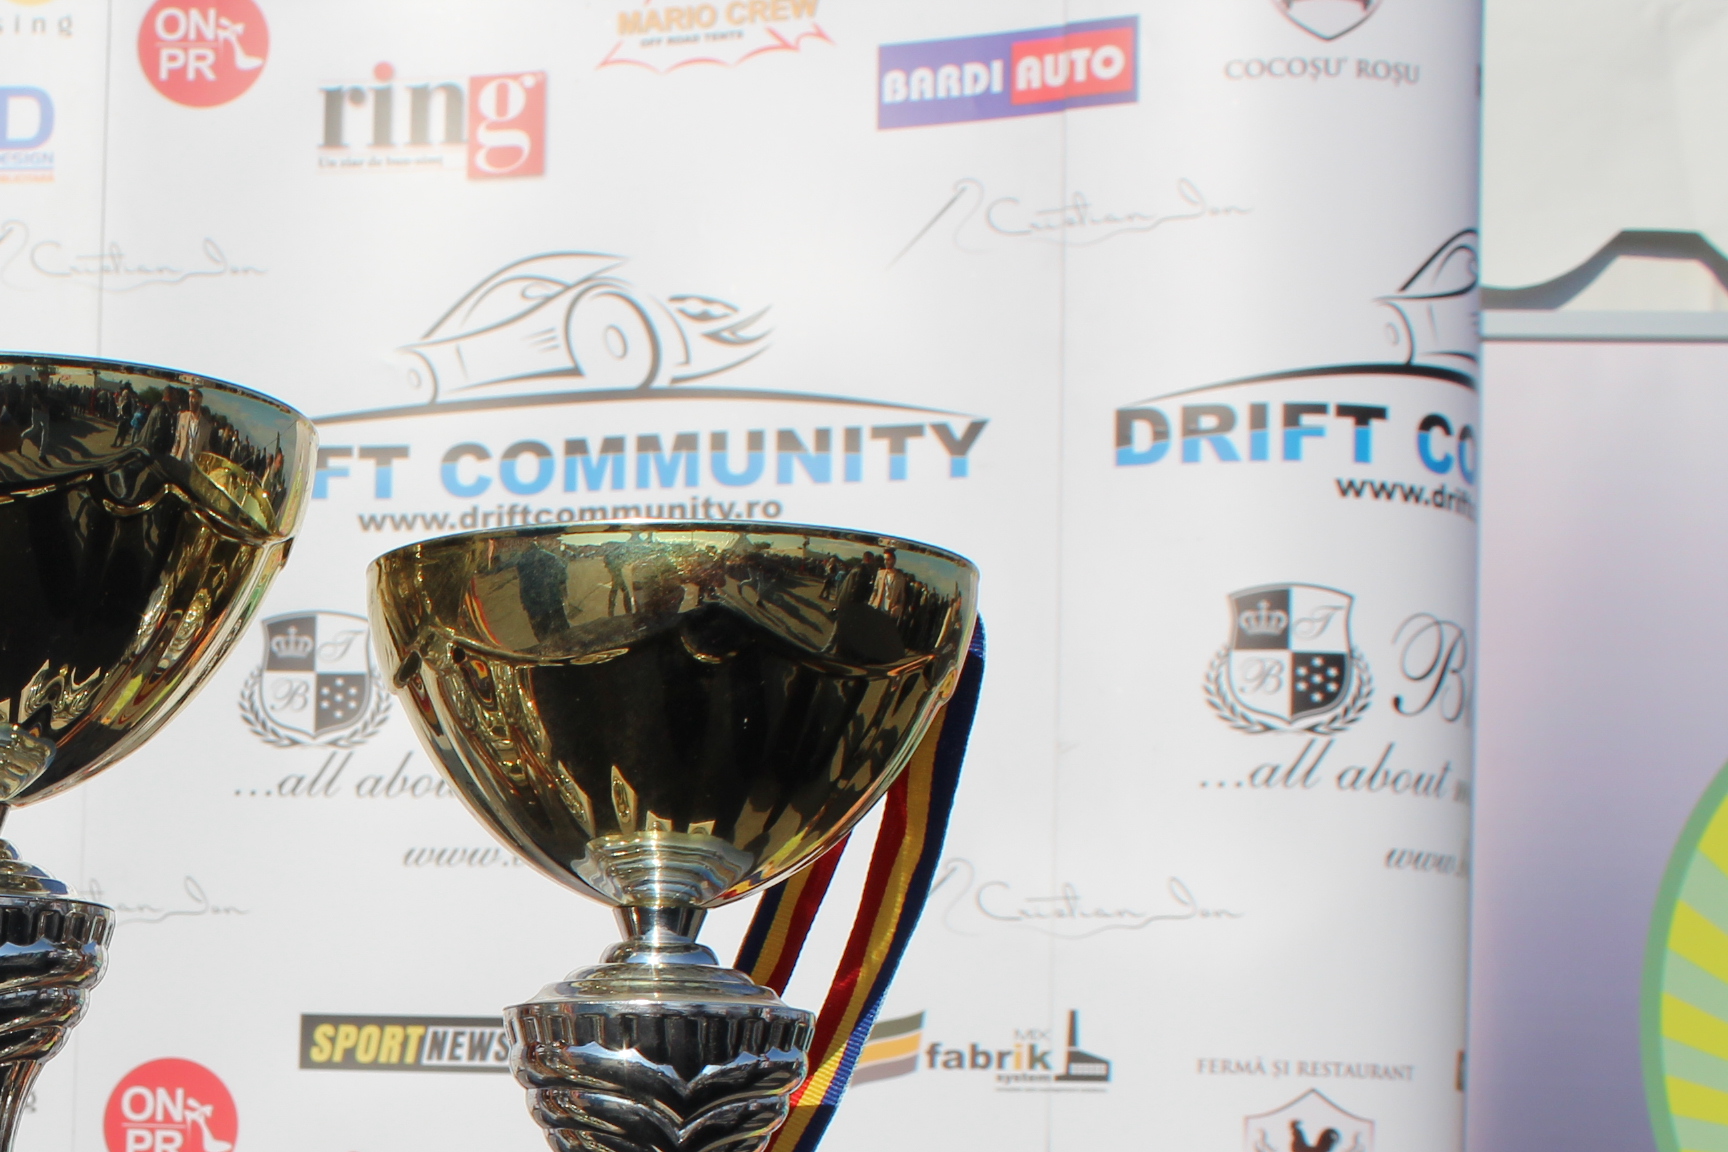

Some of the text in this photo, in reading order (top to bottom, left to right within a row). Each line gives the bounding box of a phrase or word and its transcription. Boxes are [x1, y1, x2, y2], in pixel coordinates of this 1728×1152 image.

[153, 6, 218, 43] ON
[618, 3, 718, 35] MARIO
[158, 49, 217, 83] PR
[882, 45, 1125, 105] BARDI AUTO
[317, 61, 545, 175] ring
[1114, 402, 1391, 468] DRIFT
[438, 418, 991, 500] COMMUNITY
[1335, 742, 1452, 799] about
[925, 1041, 1055, 1072] fabrik
[1296, 1060, 1416, 1082] RESTAURANT
[121, 1085, 186, 1122] ON
